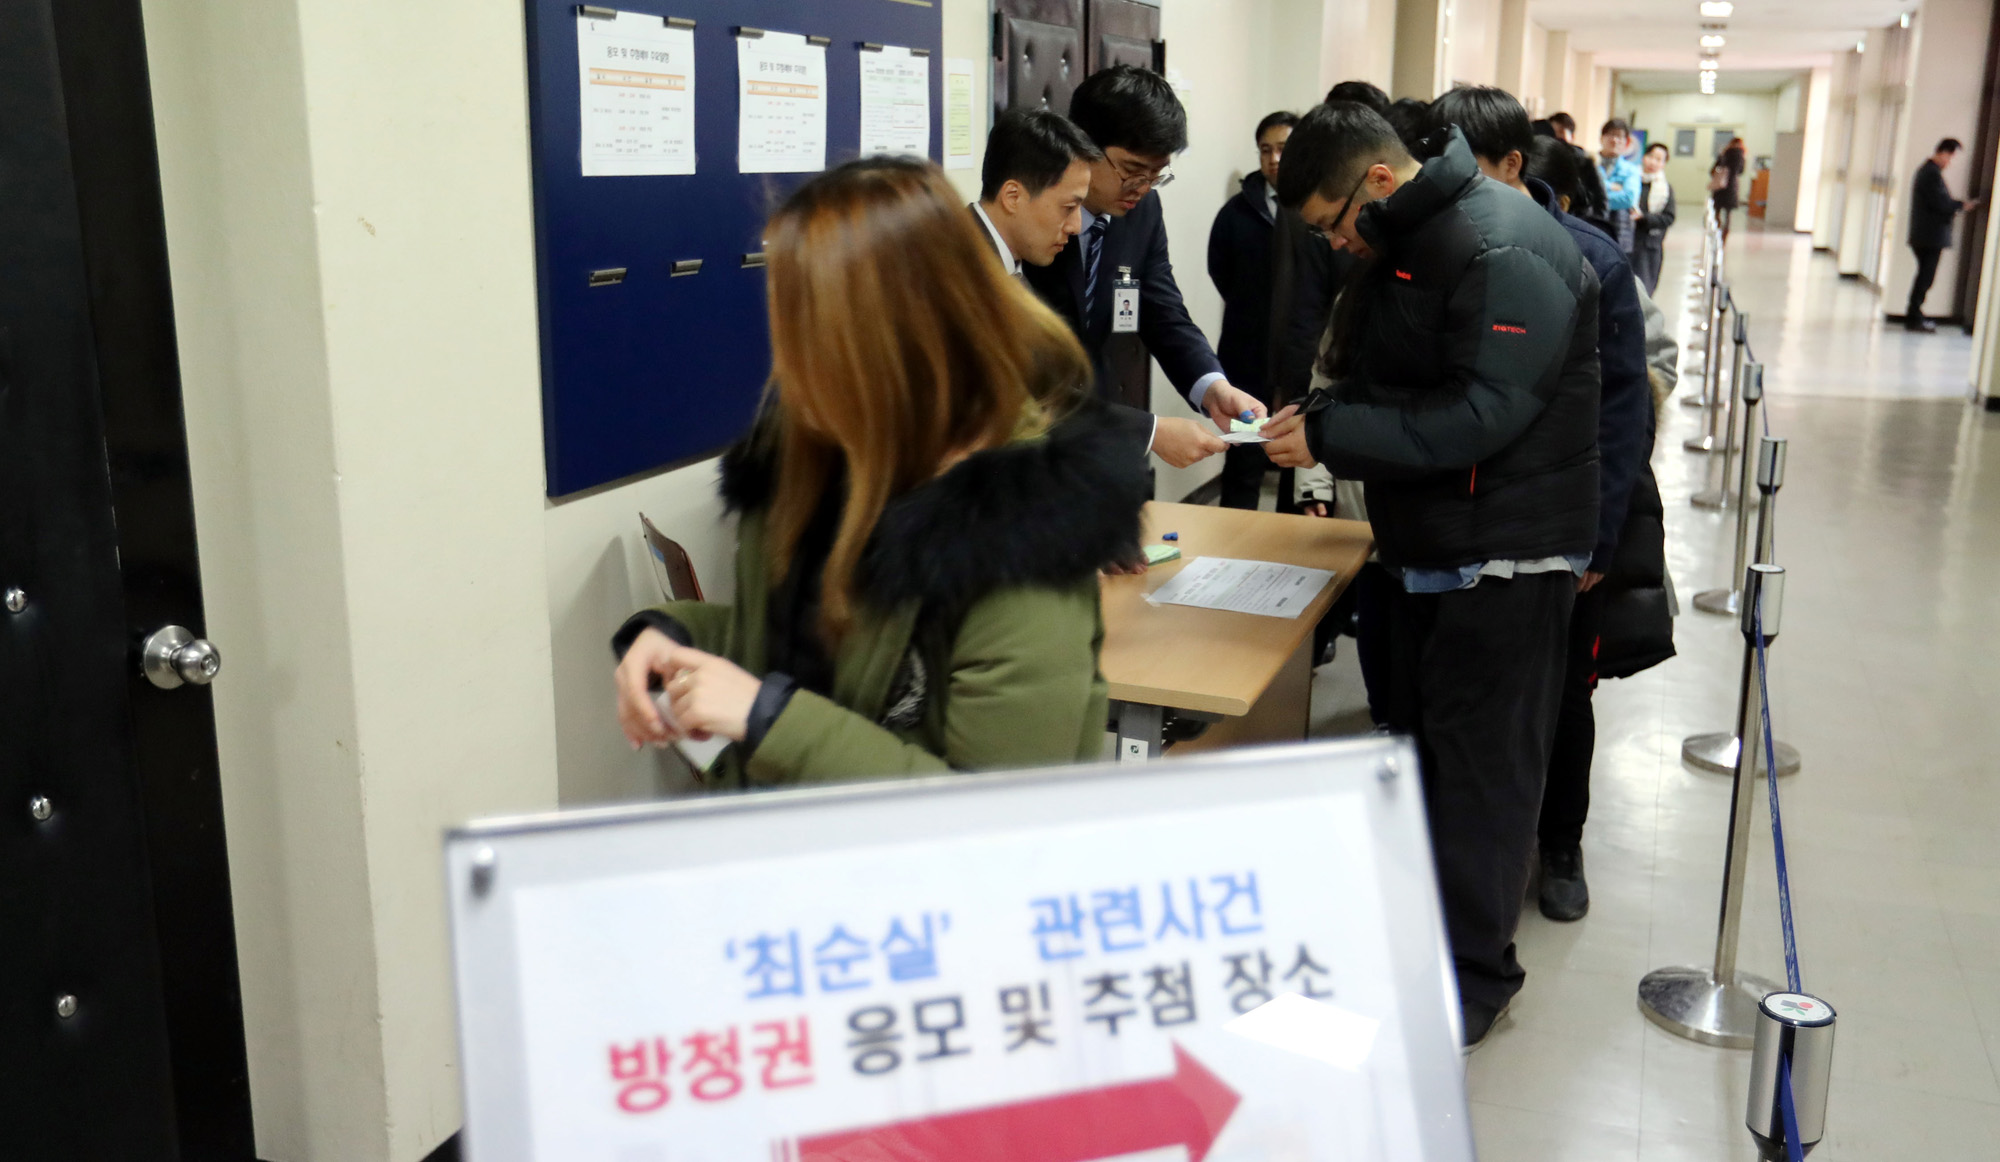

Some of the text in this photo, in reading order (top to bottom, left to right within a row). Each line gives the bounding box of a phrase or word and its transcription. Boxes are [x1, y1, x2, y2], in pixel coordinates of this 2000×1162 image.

[1027, 871, 1266, 964] 관련사건
[608, 942, 1335, 1115] 방청권 응모 및 추첨 장소
